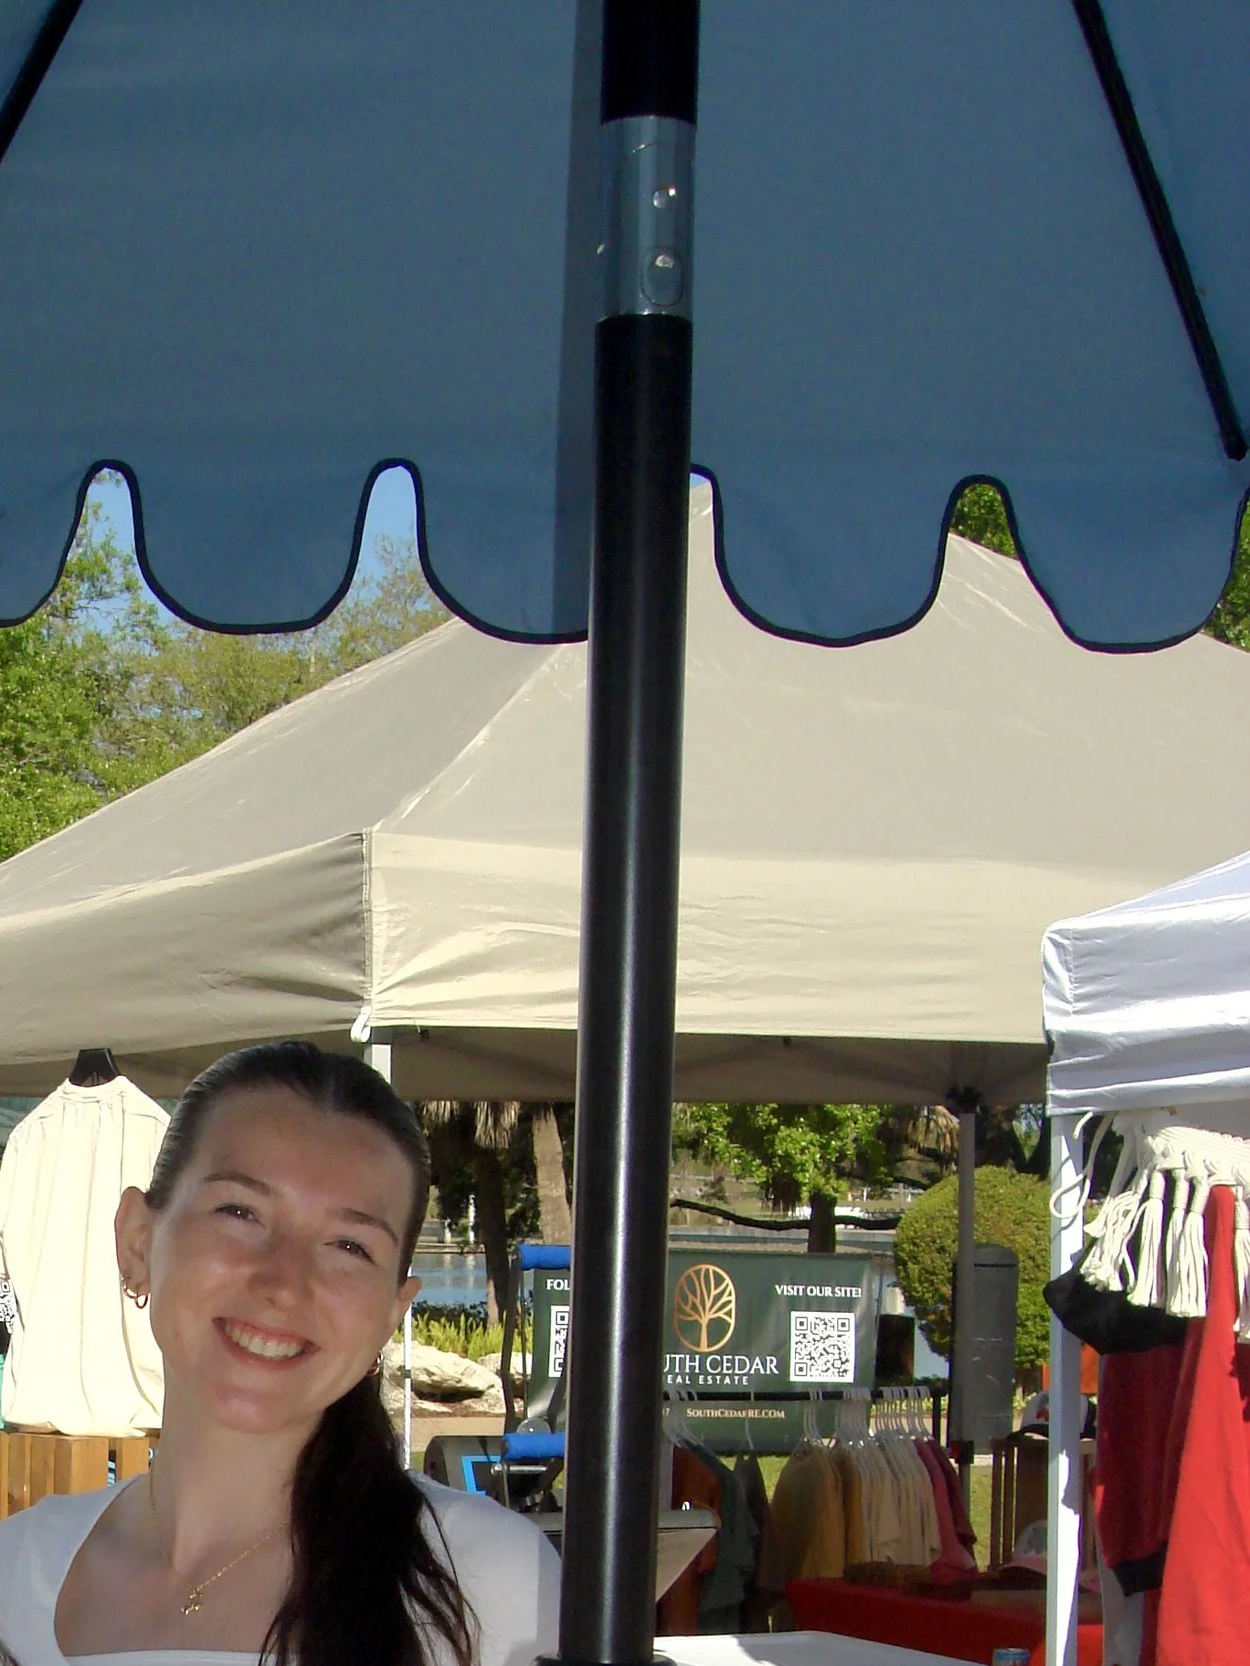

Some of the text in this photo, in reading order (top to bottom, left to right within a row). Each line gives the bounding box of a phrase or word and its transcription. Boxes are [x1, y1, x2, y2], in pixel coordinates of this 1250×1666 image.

[546, 1278, 571, 1290] FOL
[774, 1284, 862, 1298] VISIT OUR SITE!
[663, 1354, 779, 1374] UTH CEDAR
[667, 1374, 749, 1385] EAL ESTATE
